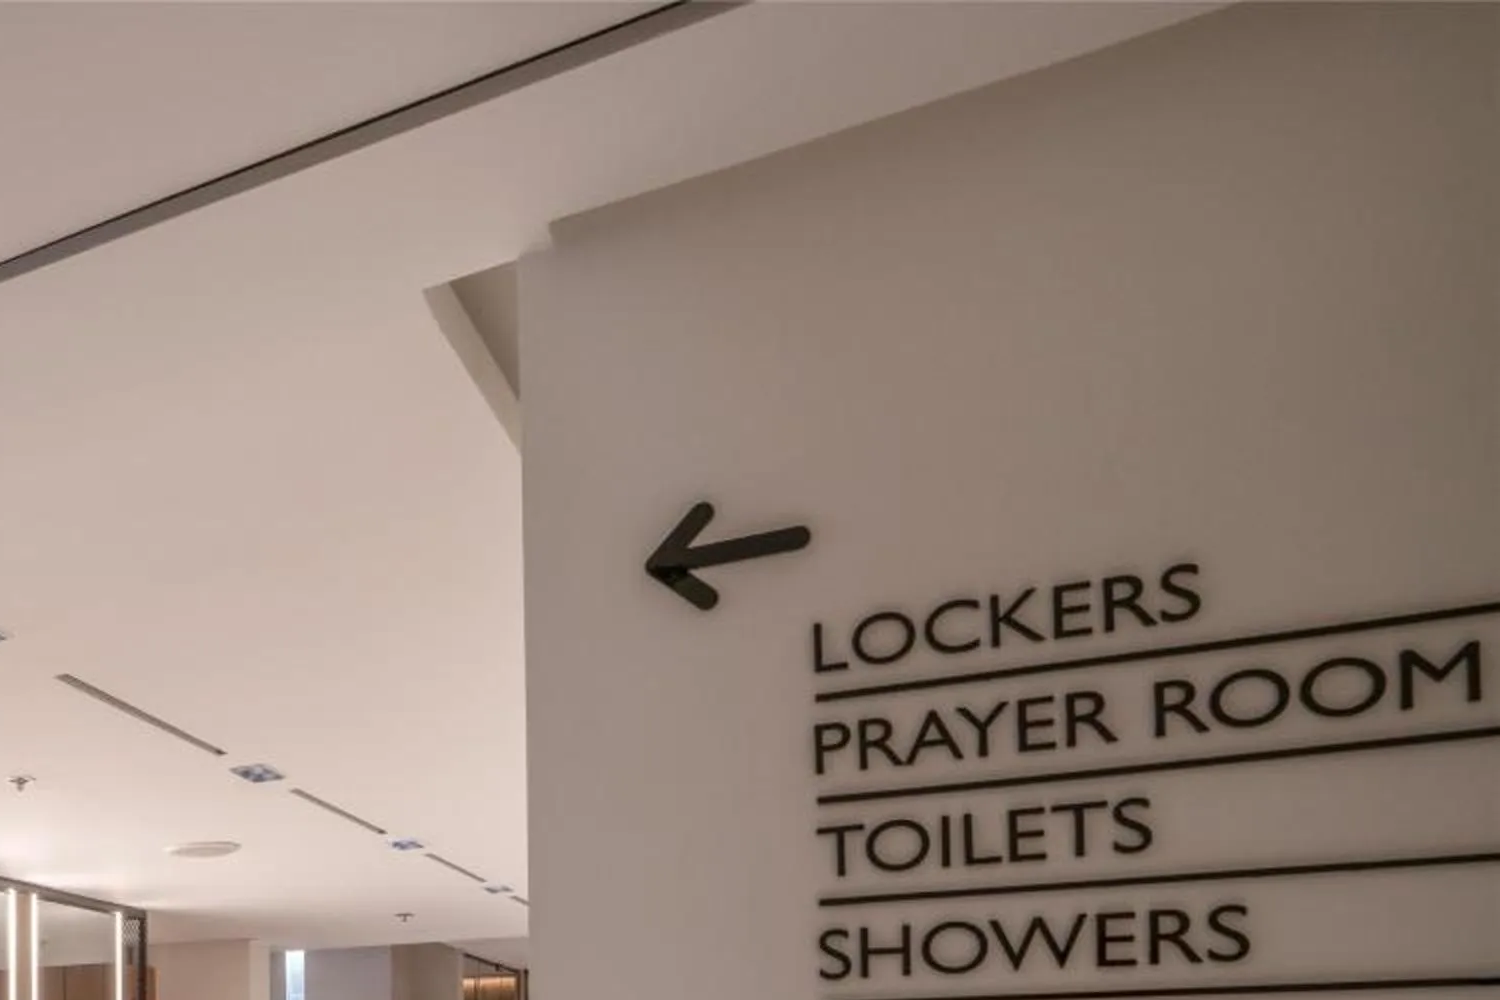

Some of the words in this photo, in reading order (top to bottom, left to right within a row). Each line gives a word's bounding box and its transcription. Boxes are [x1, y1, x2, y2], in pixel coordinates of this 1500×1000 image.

[812, 562, 1203, 675] LOCKERS
[812, 690, 1120, 776] PRAYER
[1151, 639, 1485, 741] ROOM
[815, 796, 1155, 878] TOILETS
[817, 903, 1252, 982] SHOWERS
